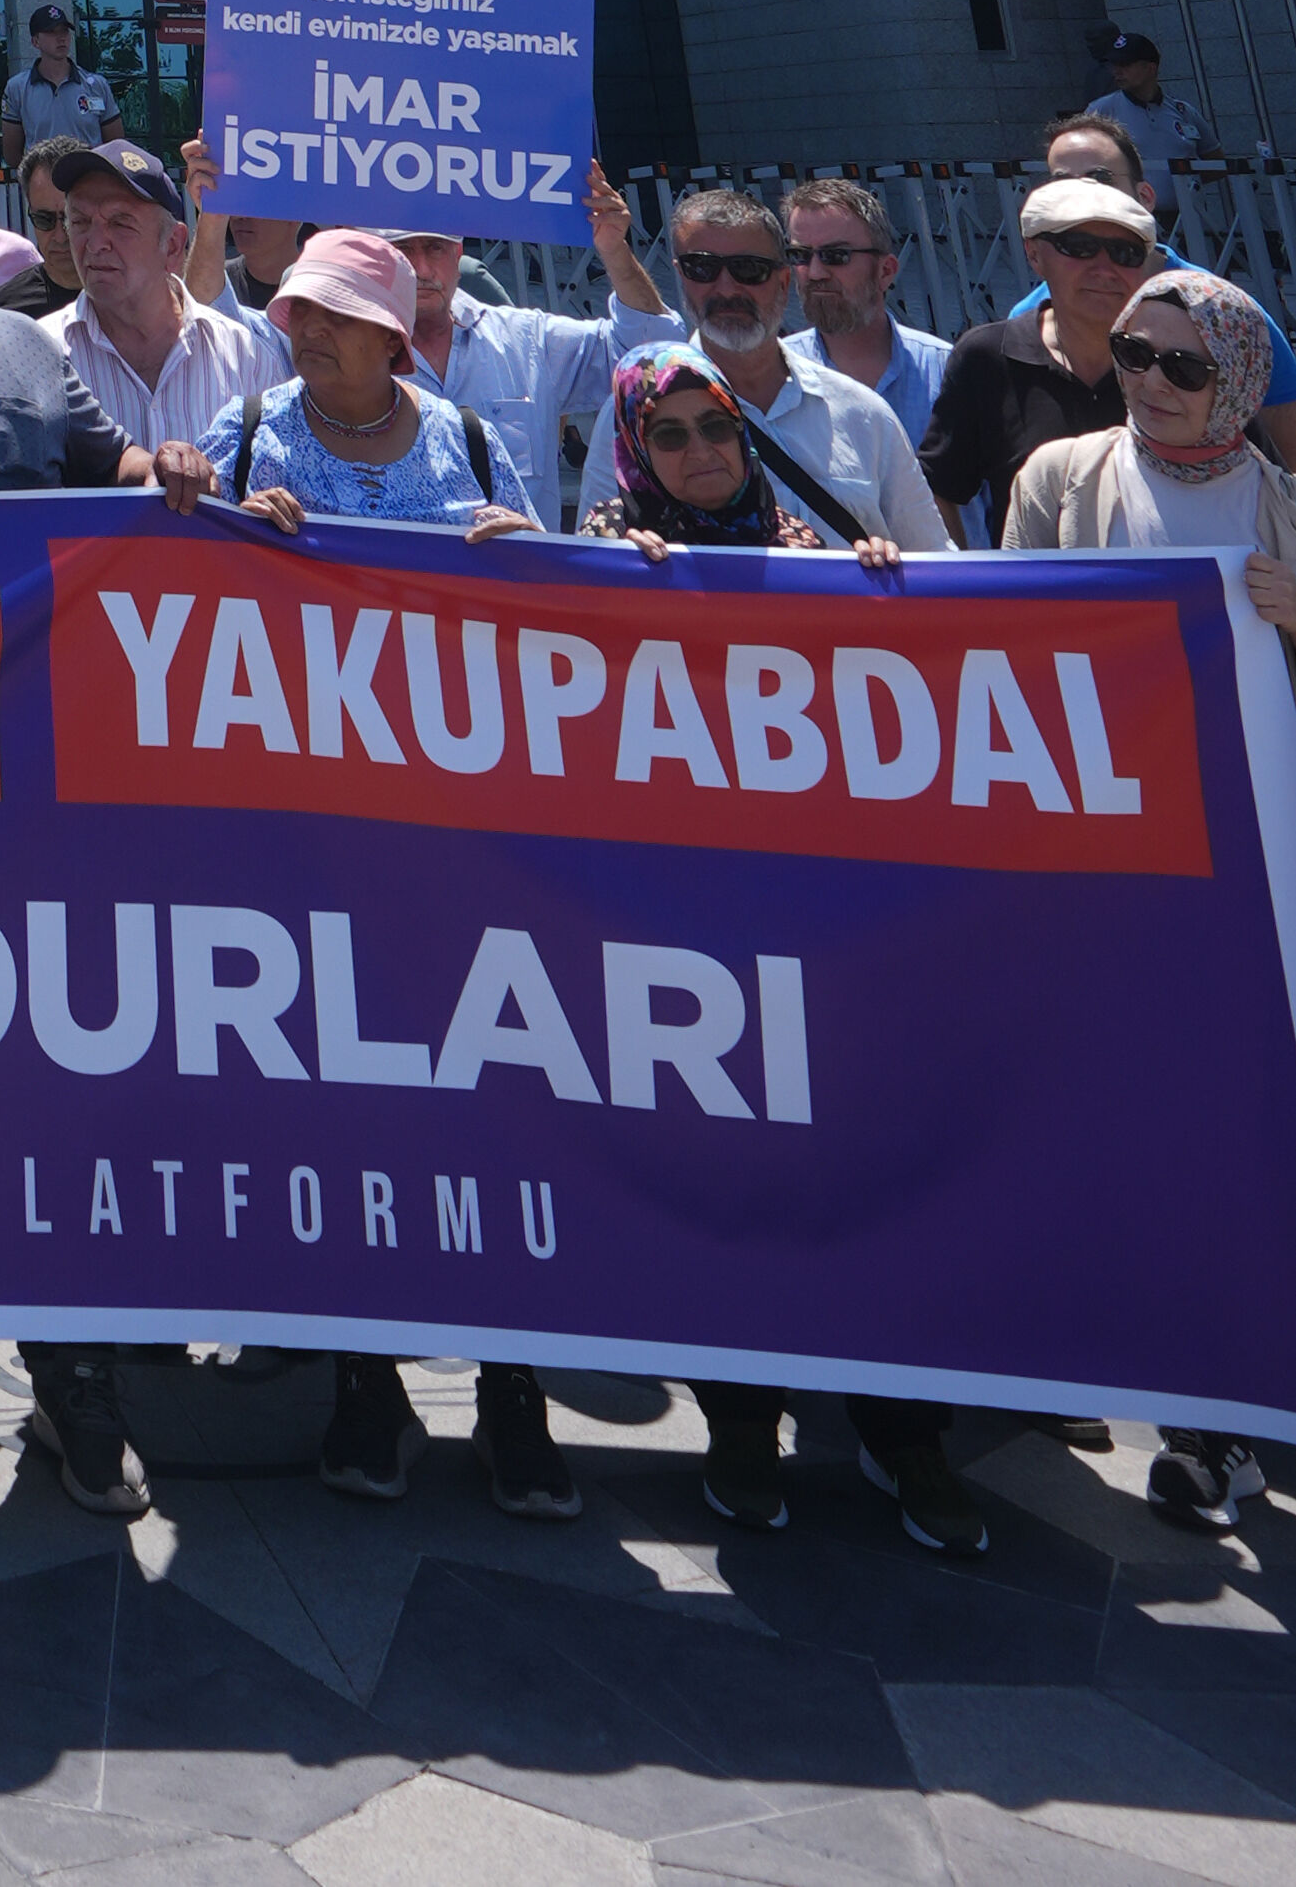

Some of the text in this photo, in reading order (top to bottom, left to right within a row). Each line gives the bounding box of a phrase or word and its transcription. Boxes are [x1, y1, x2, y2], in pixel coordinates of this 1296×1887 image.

[222, 6, 579, 58] kendi evimizde yaşamak
[313, 59, 481, 133] İMAR
[222, 114, 573, 206] İSTİYORUZ
[97, 590, 1142, 815] YAKUPABDAL
